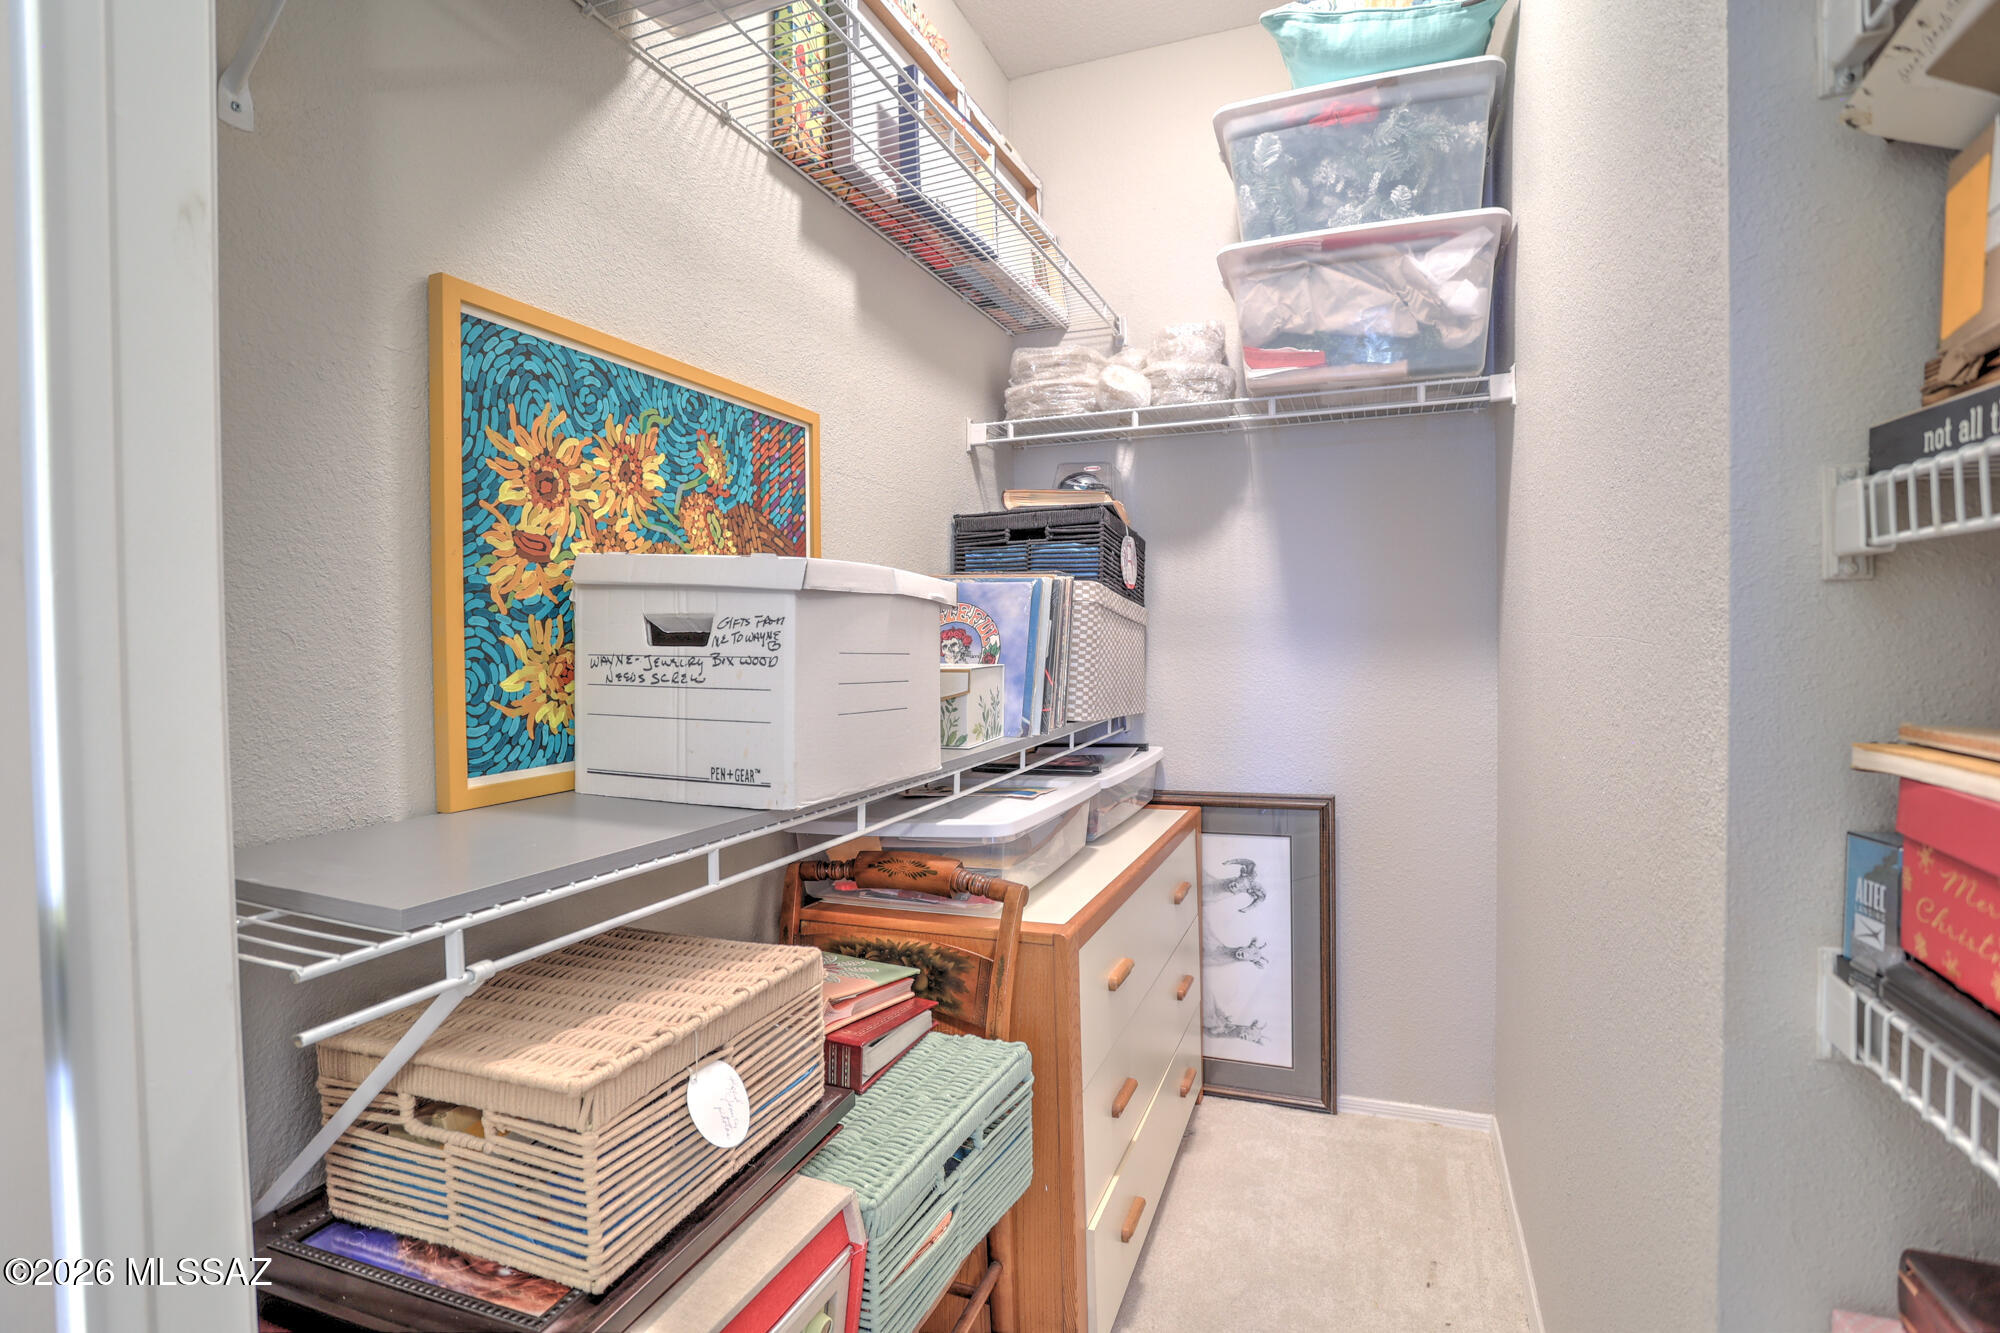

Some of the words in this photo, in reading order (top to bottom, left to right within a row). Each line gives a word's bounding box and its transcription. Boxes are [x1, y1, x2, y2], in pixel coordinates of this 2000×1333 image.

[1923, 416, 1952, 454] not
[1958, 405, 1983, 443] all
[716, 616, 751, 630] GIFTS
[754, 614, 786, 628] FROM
[731, 631, 744, 644] TO
[745, 630, 782, 648] WAYNE
[642, 654, 704, 675] JEWELRY
[739, 655, 779, 668] WOOD
[605, 670, 646, 685] NEEDS
[651, 674, 706, 685] SCREW
[1855, 876, 1886, 913] ALTEC
